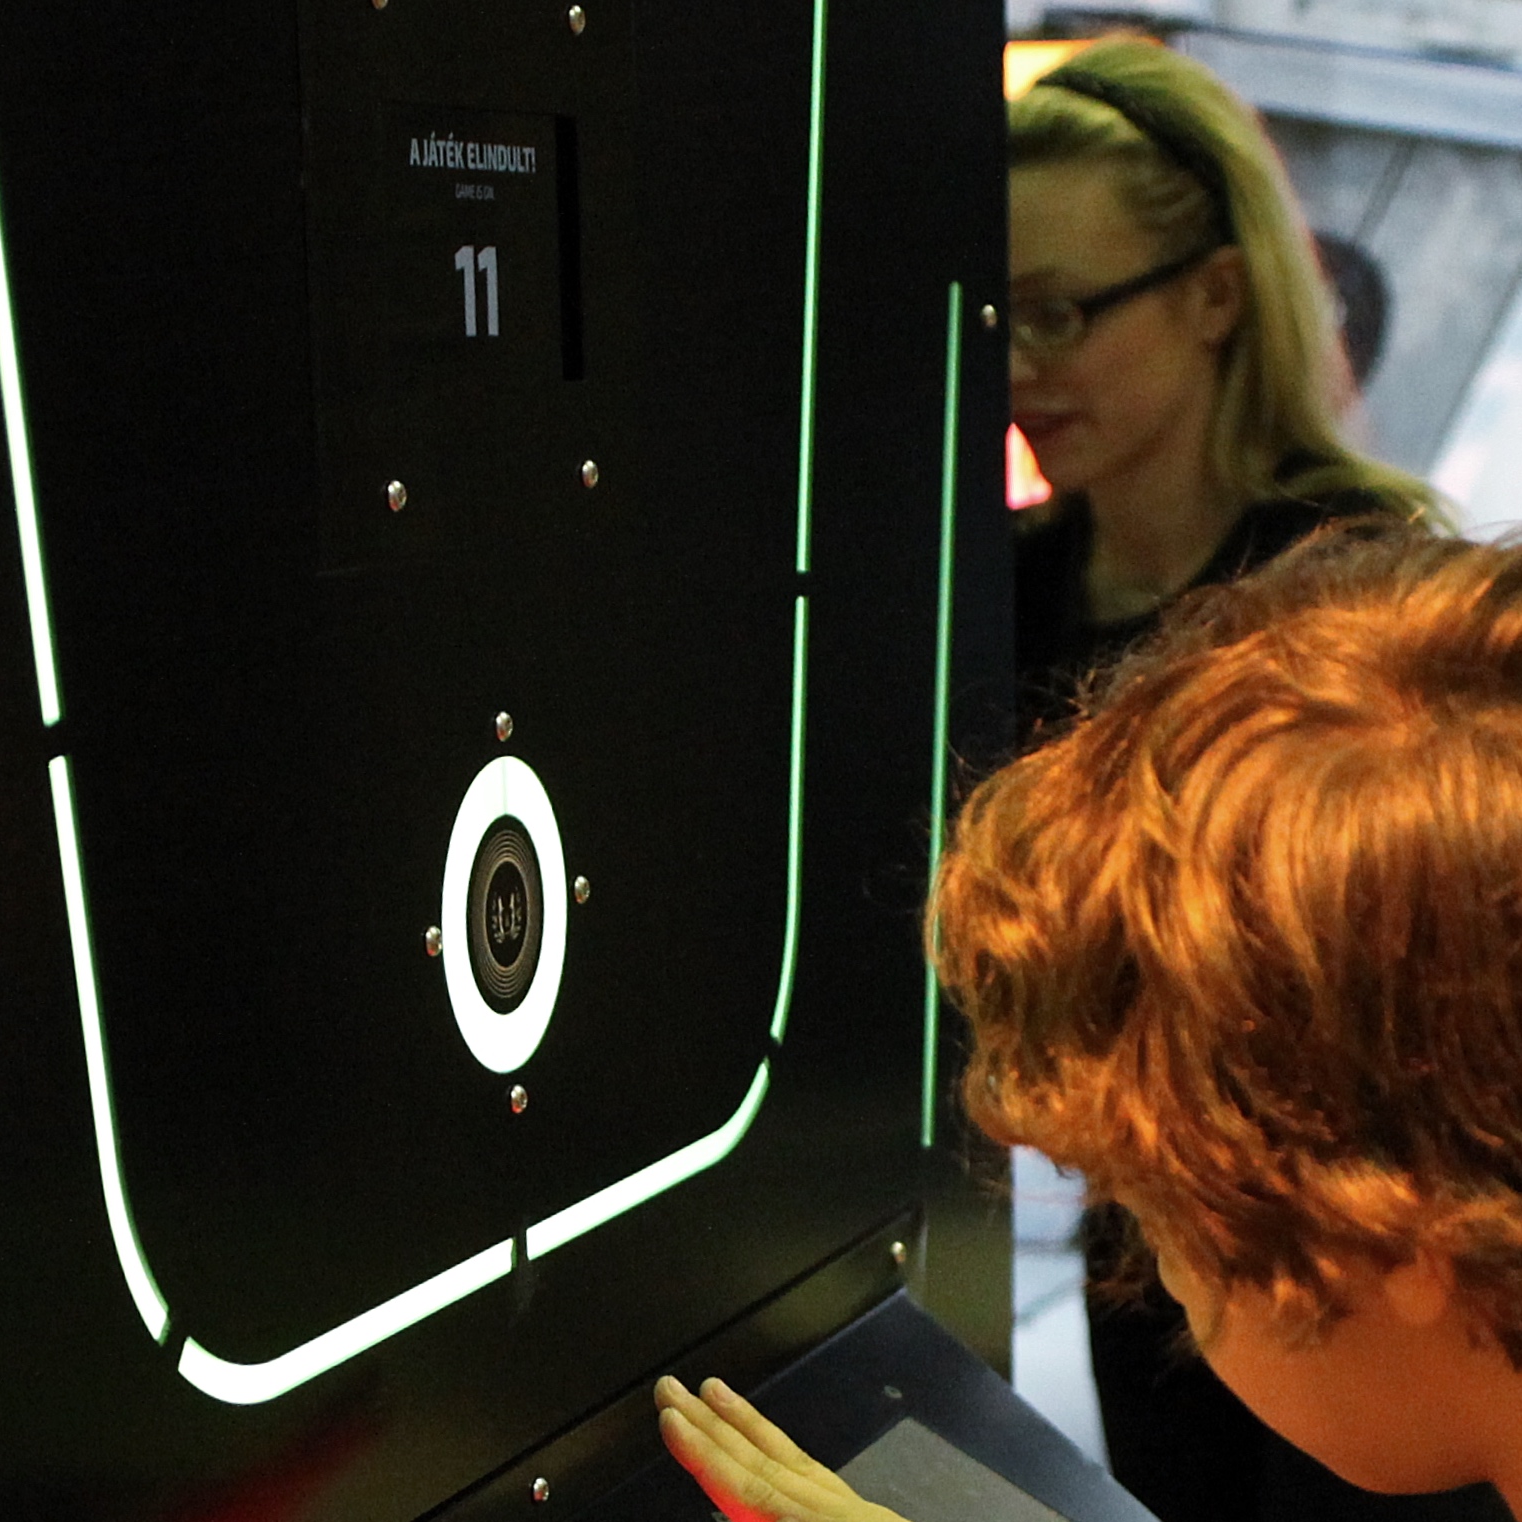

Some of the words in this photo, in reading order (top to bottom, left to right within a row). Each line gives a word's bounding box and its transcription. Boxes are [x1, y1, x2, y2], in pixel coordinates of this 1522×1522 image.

[409, 137, 421, 166] A
[422, 130, 466, 170] JÁTÉK
[466, 142, 537, 174] ELINDULT!
[454, 245, 499, 337] 11
